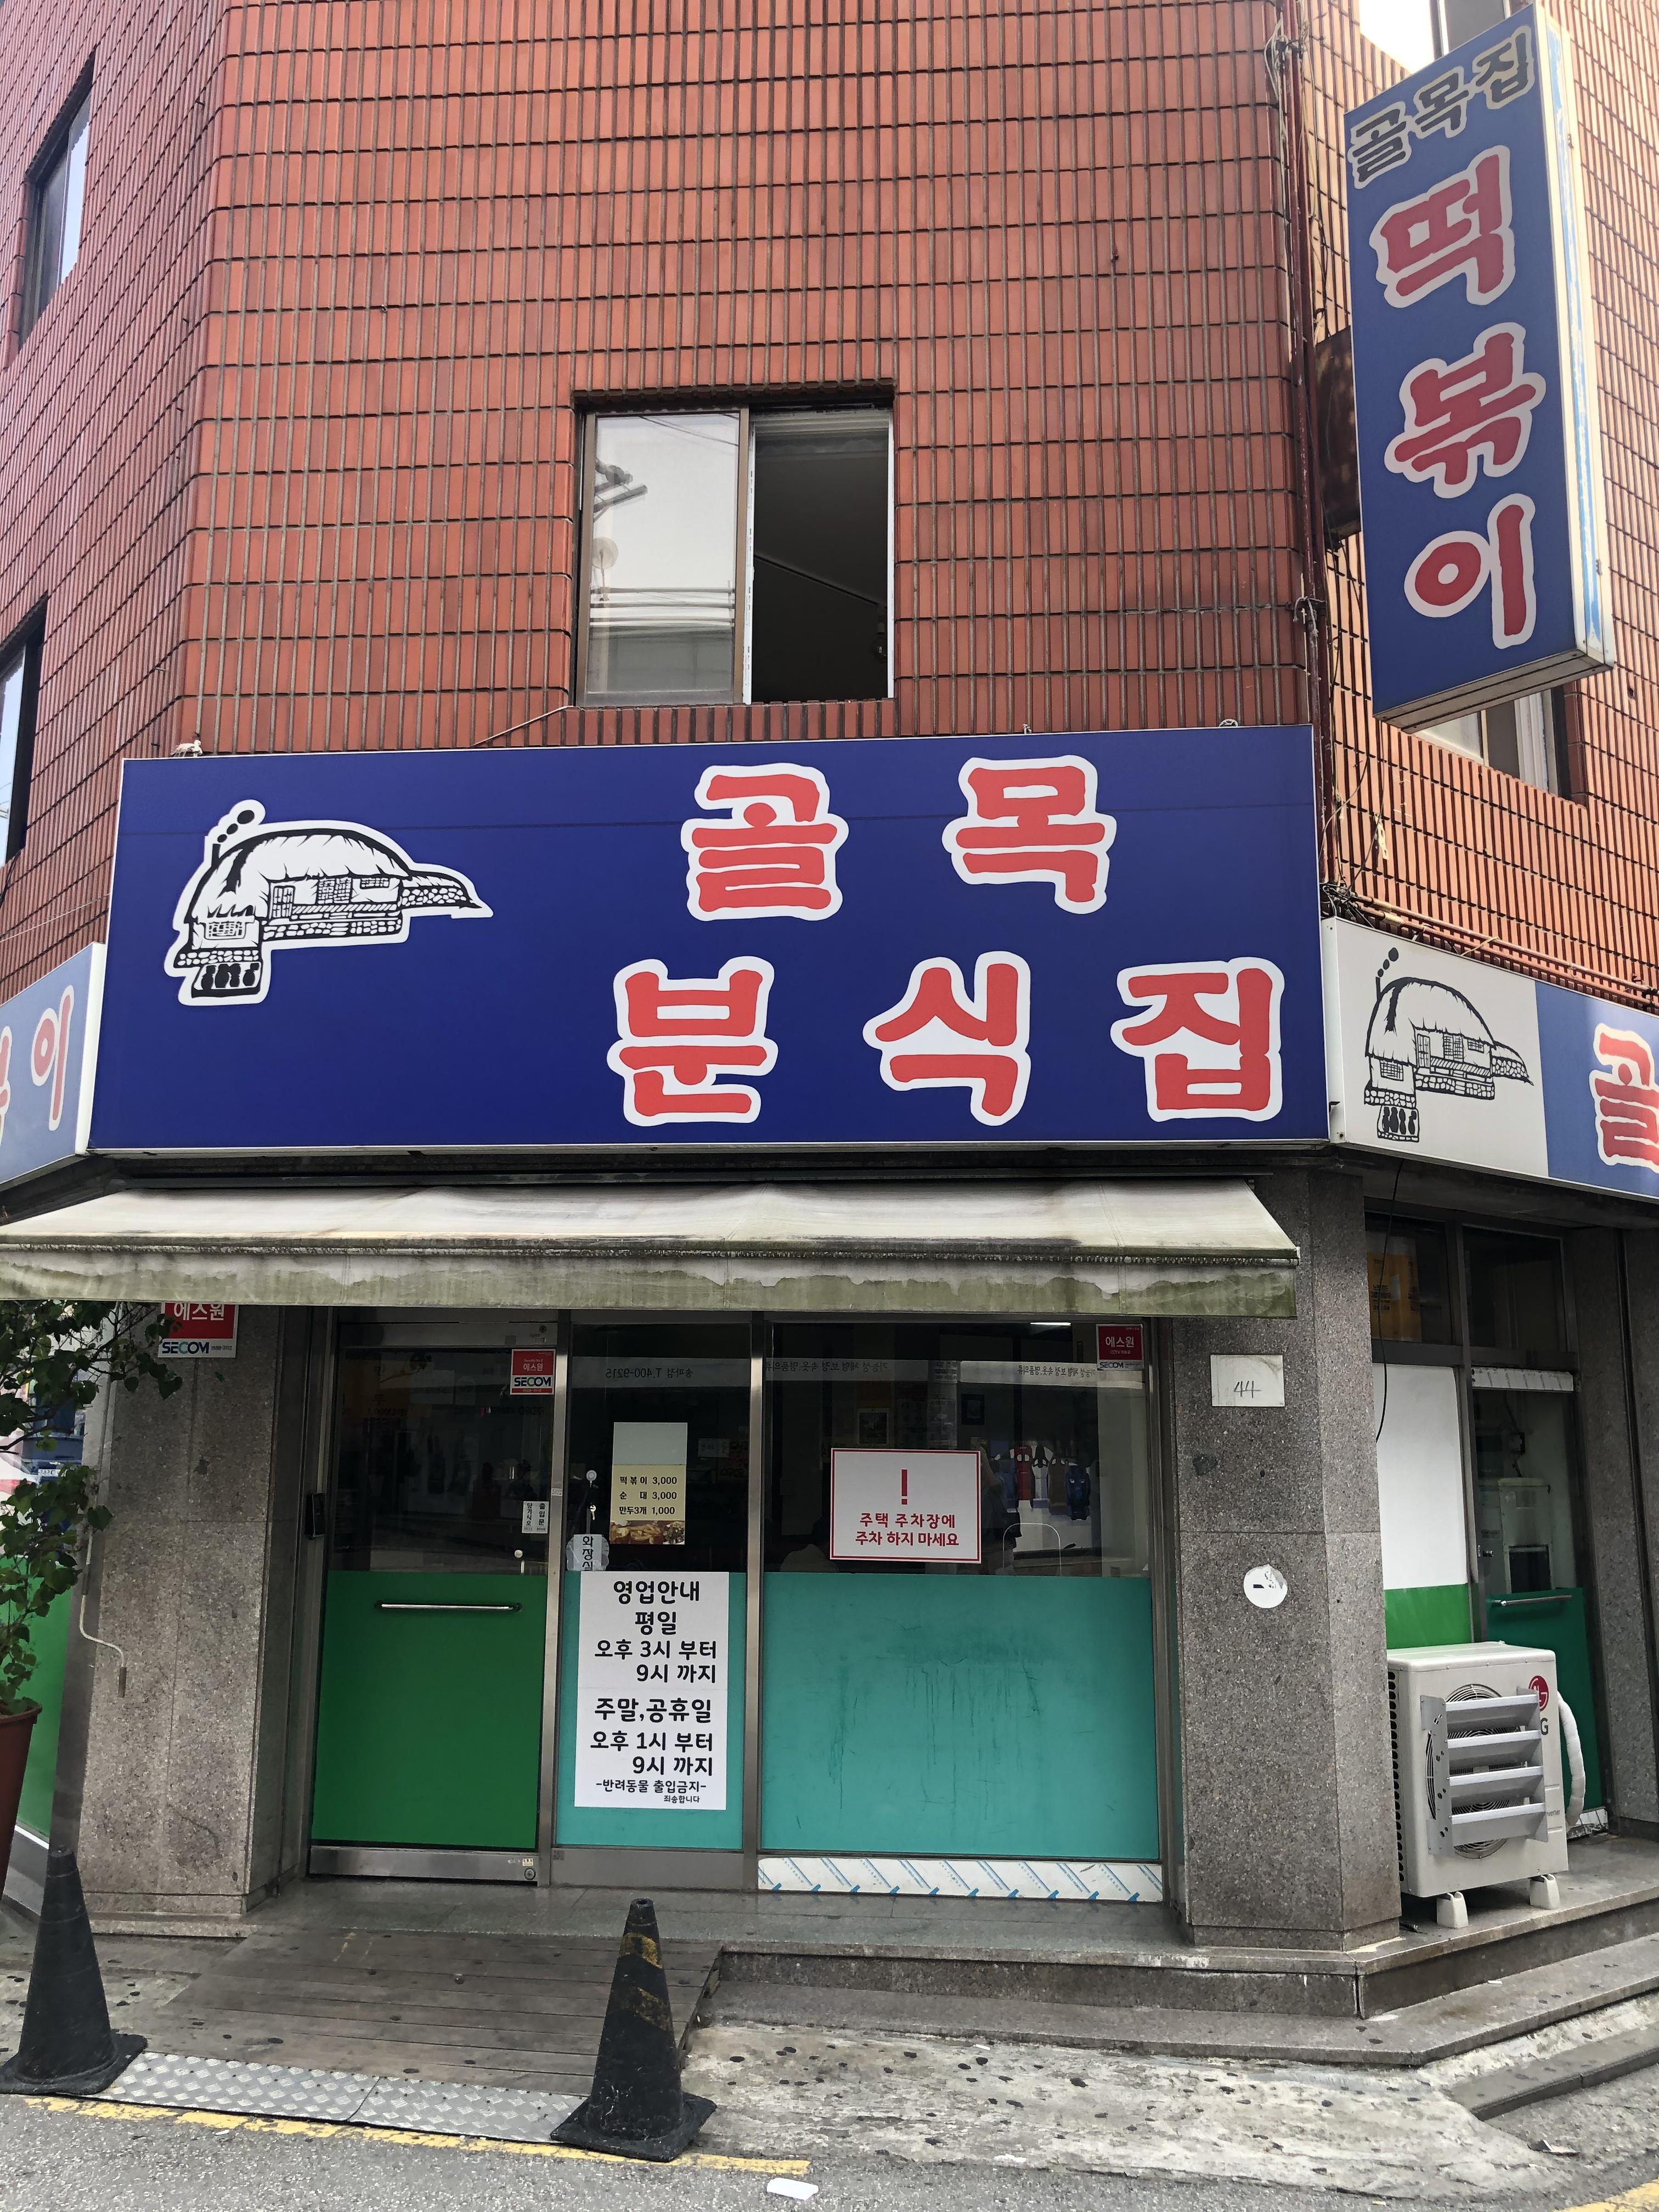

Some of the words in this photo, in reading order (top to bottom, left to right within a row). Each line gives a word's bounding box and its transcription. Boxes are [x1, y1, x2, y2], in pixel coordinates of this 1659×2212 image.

[1348, 26, 1534, 189] 골목집
[1369, 145, 1546, 649] 떡볶이
[681, 755, 1116, 920] 골목
[607, 951, 1284, 1125] 분식집
[173, 1302, 225, 1321] 에스원
[162, 1341, 210, 1354] SECOM
[1105, 1336, 1134, 1348] 에스원
[523, 1363, 543, 1372] 에스원
[514, 1376, 551, 1387] SECOM
[1233, 1380, 1261, 1398] 44
[652, 1476, 678, 1486] 3,000
[652, 1492, 678, 1501] 3,000
[619, 1506, 647, 1515] 만두3개
[651, 1506, 675, 1516] 1,000
[860, 1513, 889, 1528] 주택
[895, 1513, 955, 1530] 주차장에
[855, 1531, 883, 1545] 주차
[887, 1531, 913, 1546] 하지
[918, 1532, 960, 1547] 마세요
[613, 1581, 699, 1605] 영업안내
[635, 1611, 677, 1635] 평일
[594, 1639, 633, 1660] 오후
[640, 1640, 670, 1660] 3시
[678, 1640, 717, 1661] 부터
[636, 1664, 669, 1683] 9시
[676, 1664, 716, 1684] 까지
[594, 1697, 712, 1723] 주말,공휴일
[590, 1730, 629, 1752] 오후
[636, 1732, 667, 1751] 1시
[674, 1733, 713, 1753] 부터
[632, 1756, 665, 1775] 9시
[674, 1757, 713, 1776] 까지
[663, 1795, 701, 1804] 죄송합니다
